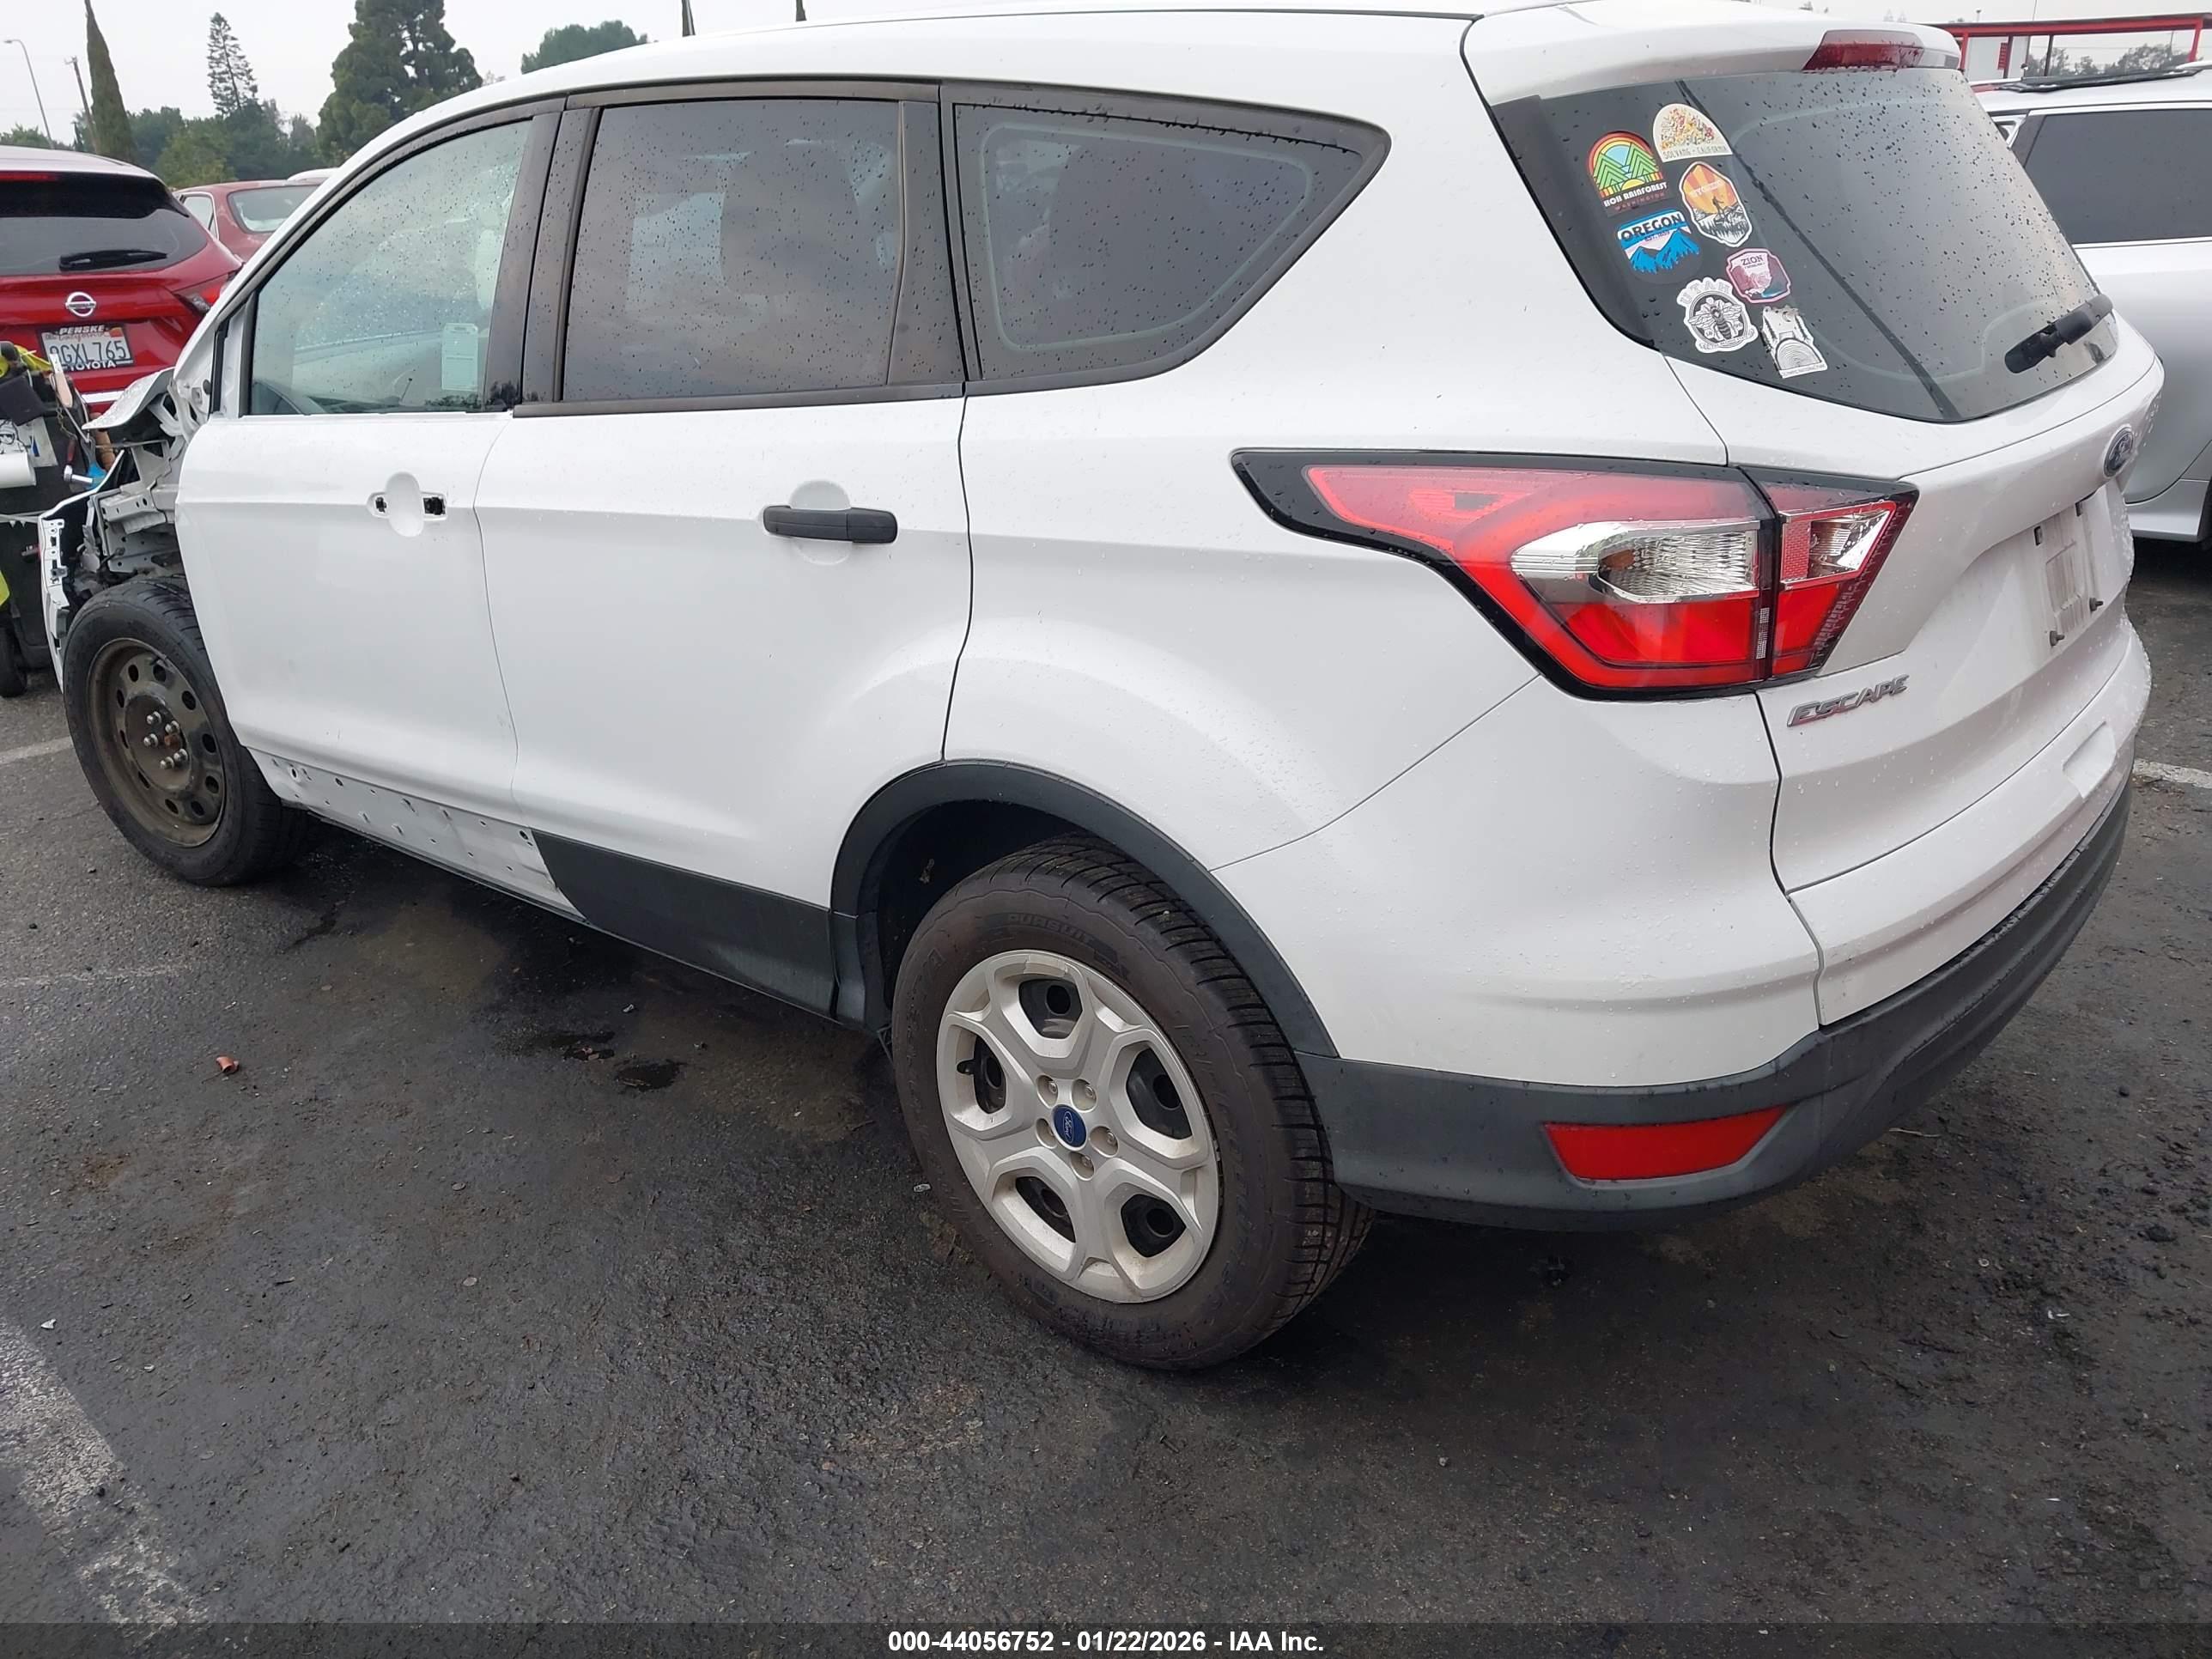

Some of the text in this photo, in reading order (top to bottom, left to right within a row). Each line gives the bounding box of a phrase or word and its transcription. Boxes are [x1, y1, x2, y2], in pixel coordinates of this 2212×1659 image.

[1603, 181, 1668, 208] HOH RAINFOREST
[1621, 213, 1683, 240] OREGON
[1741, 254, 1764, 266] ZION
[1680, 280, 1731, 303] UTAH
[59, 325, 105, 335] PENSKE
[70, 360, 117, 371] TOYOTA
[1787, 674, 1910, 727] ESCAPE
